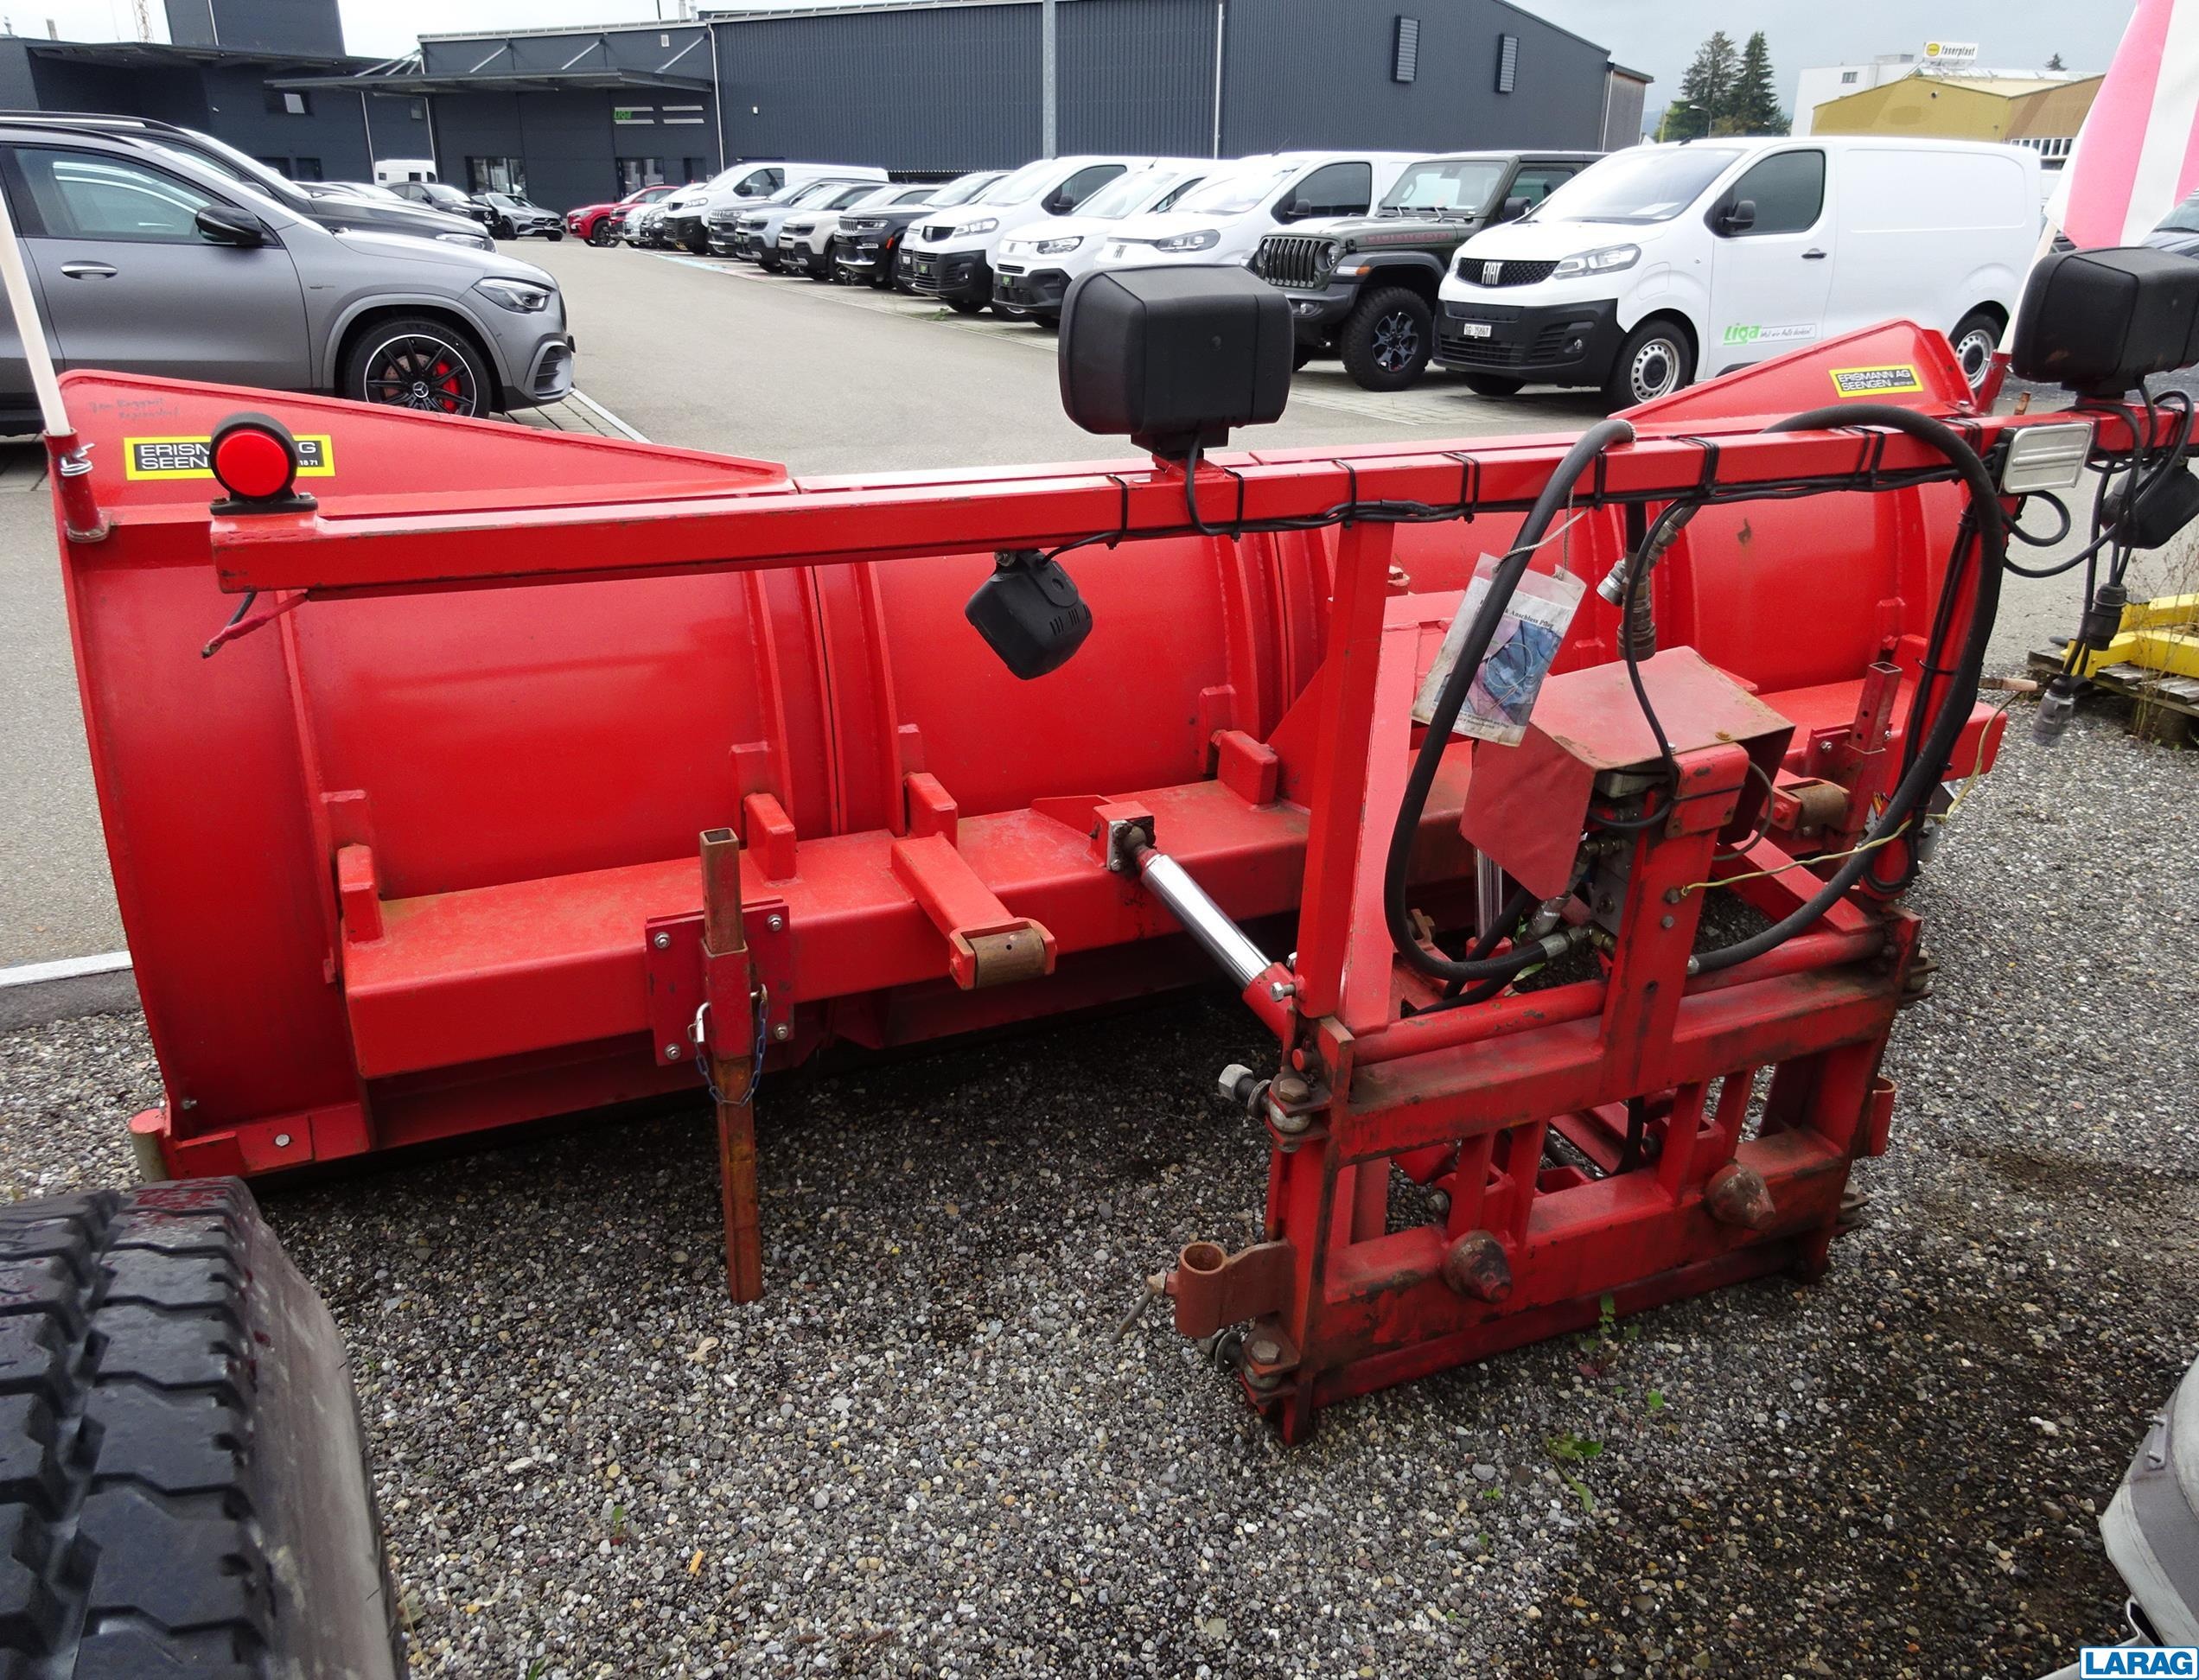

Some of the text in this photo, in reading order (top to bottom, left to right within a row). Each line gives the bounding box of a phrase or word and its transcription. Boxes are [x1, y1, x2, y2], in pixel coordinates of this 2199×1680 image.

[1941, 45, 1975, 57] faserplast
[1482, 261, 1502, 285] FIAT
[1837, 369, 1910, 383] ERISMANN AG
[1841, 379, 1892, 391] SEENGEN
[140, 442, 316, 457] ERISM G
[141, 455, 208, 470] SEEN
